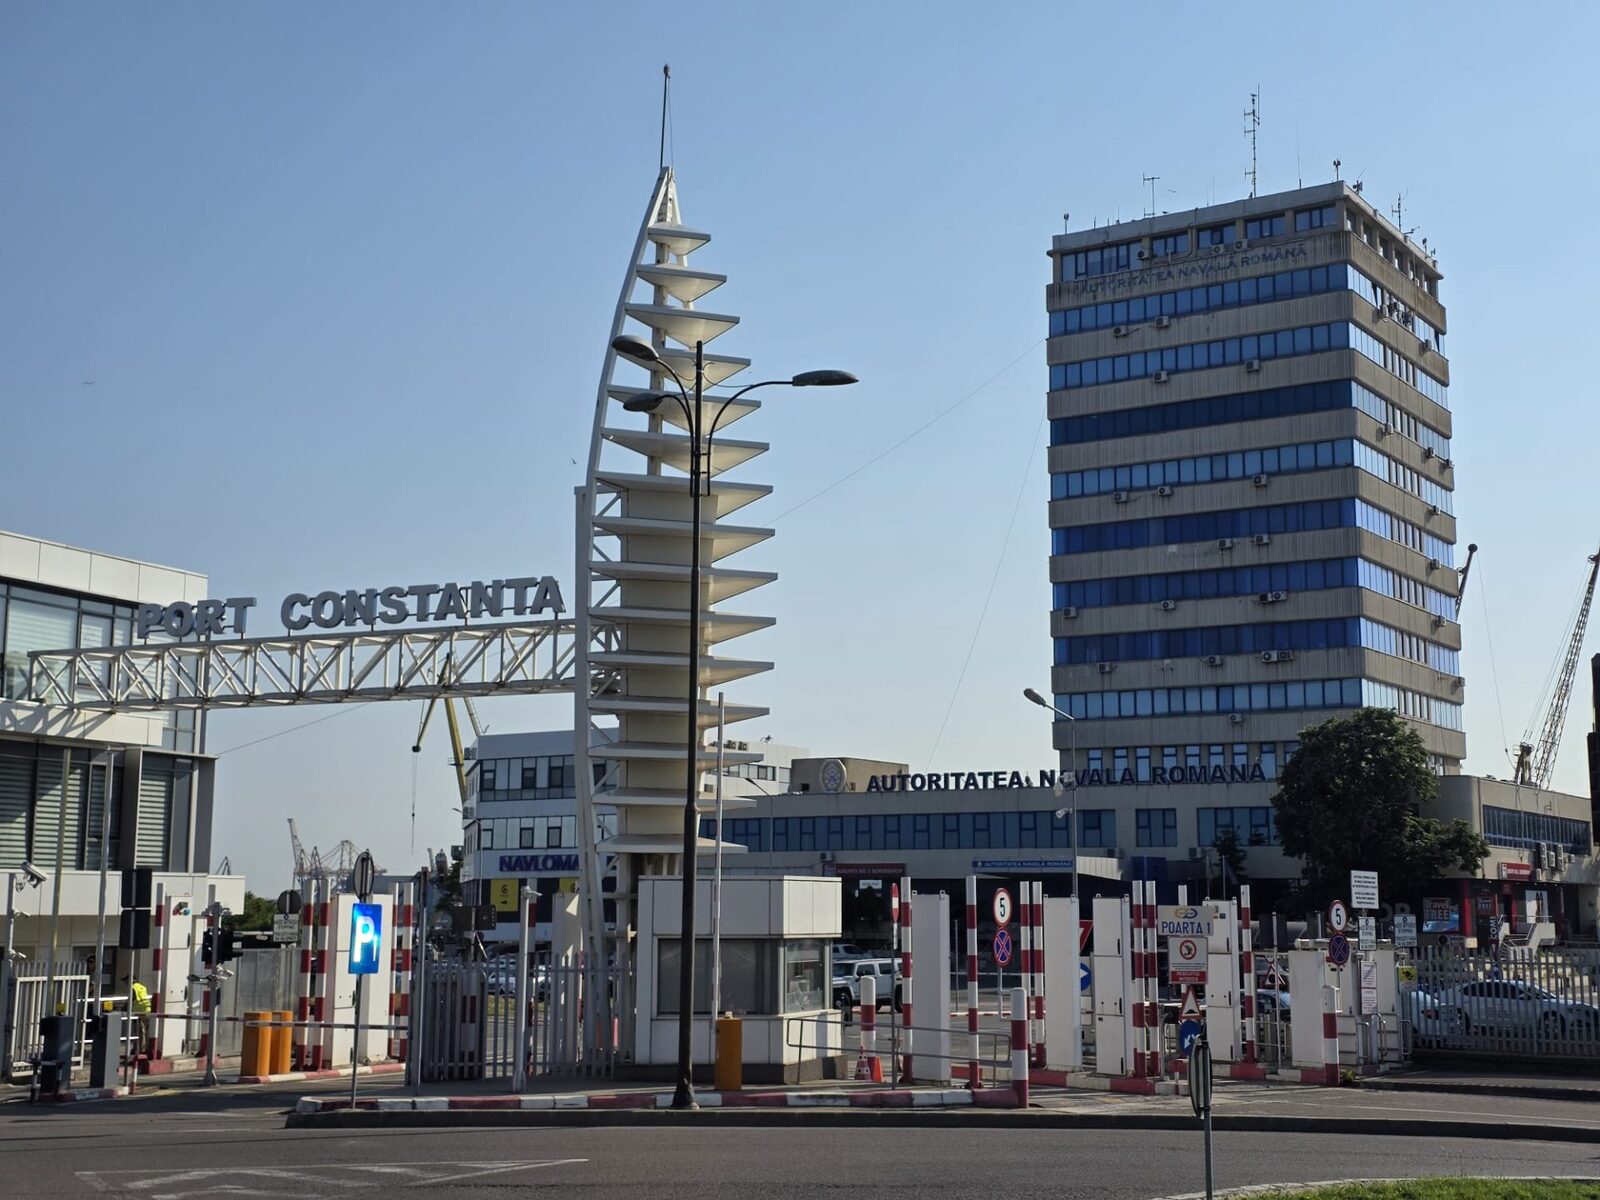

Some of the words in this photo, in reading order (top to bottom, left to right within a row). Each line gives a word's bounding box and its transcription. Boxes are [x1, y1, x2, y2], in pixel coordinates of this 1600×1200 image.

[137, 596, 257, 640] PORT
[280, 575, 566, 630] CONSTANTA
[867, 770, 1023, 793] AUTORITATEA
[1039, 767, 1136, 788] NVALA
[1000, 897, 1006, 917] 5
[1424, 910, 1450, 921] FREE
[1335, 909, 1341, 925] 5
[1161, 921, 1203, 934] POARTA
[1207, 922, 1211, 934] 1
